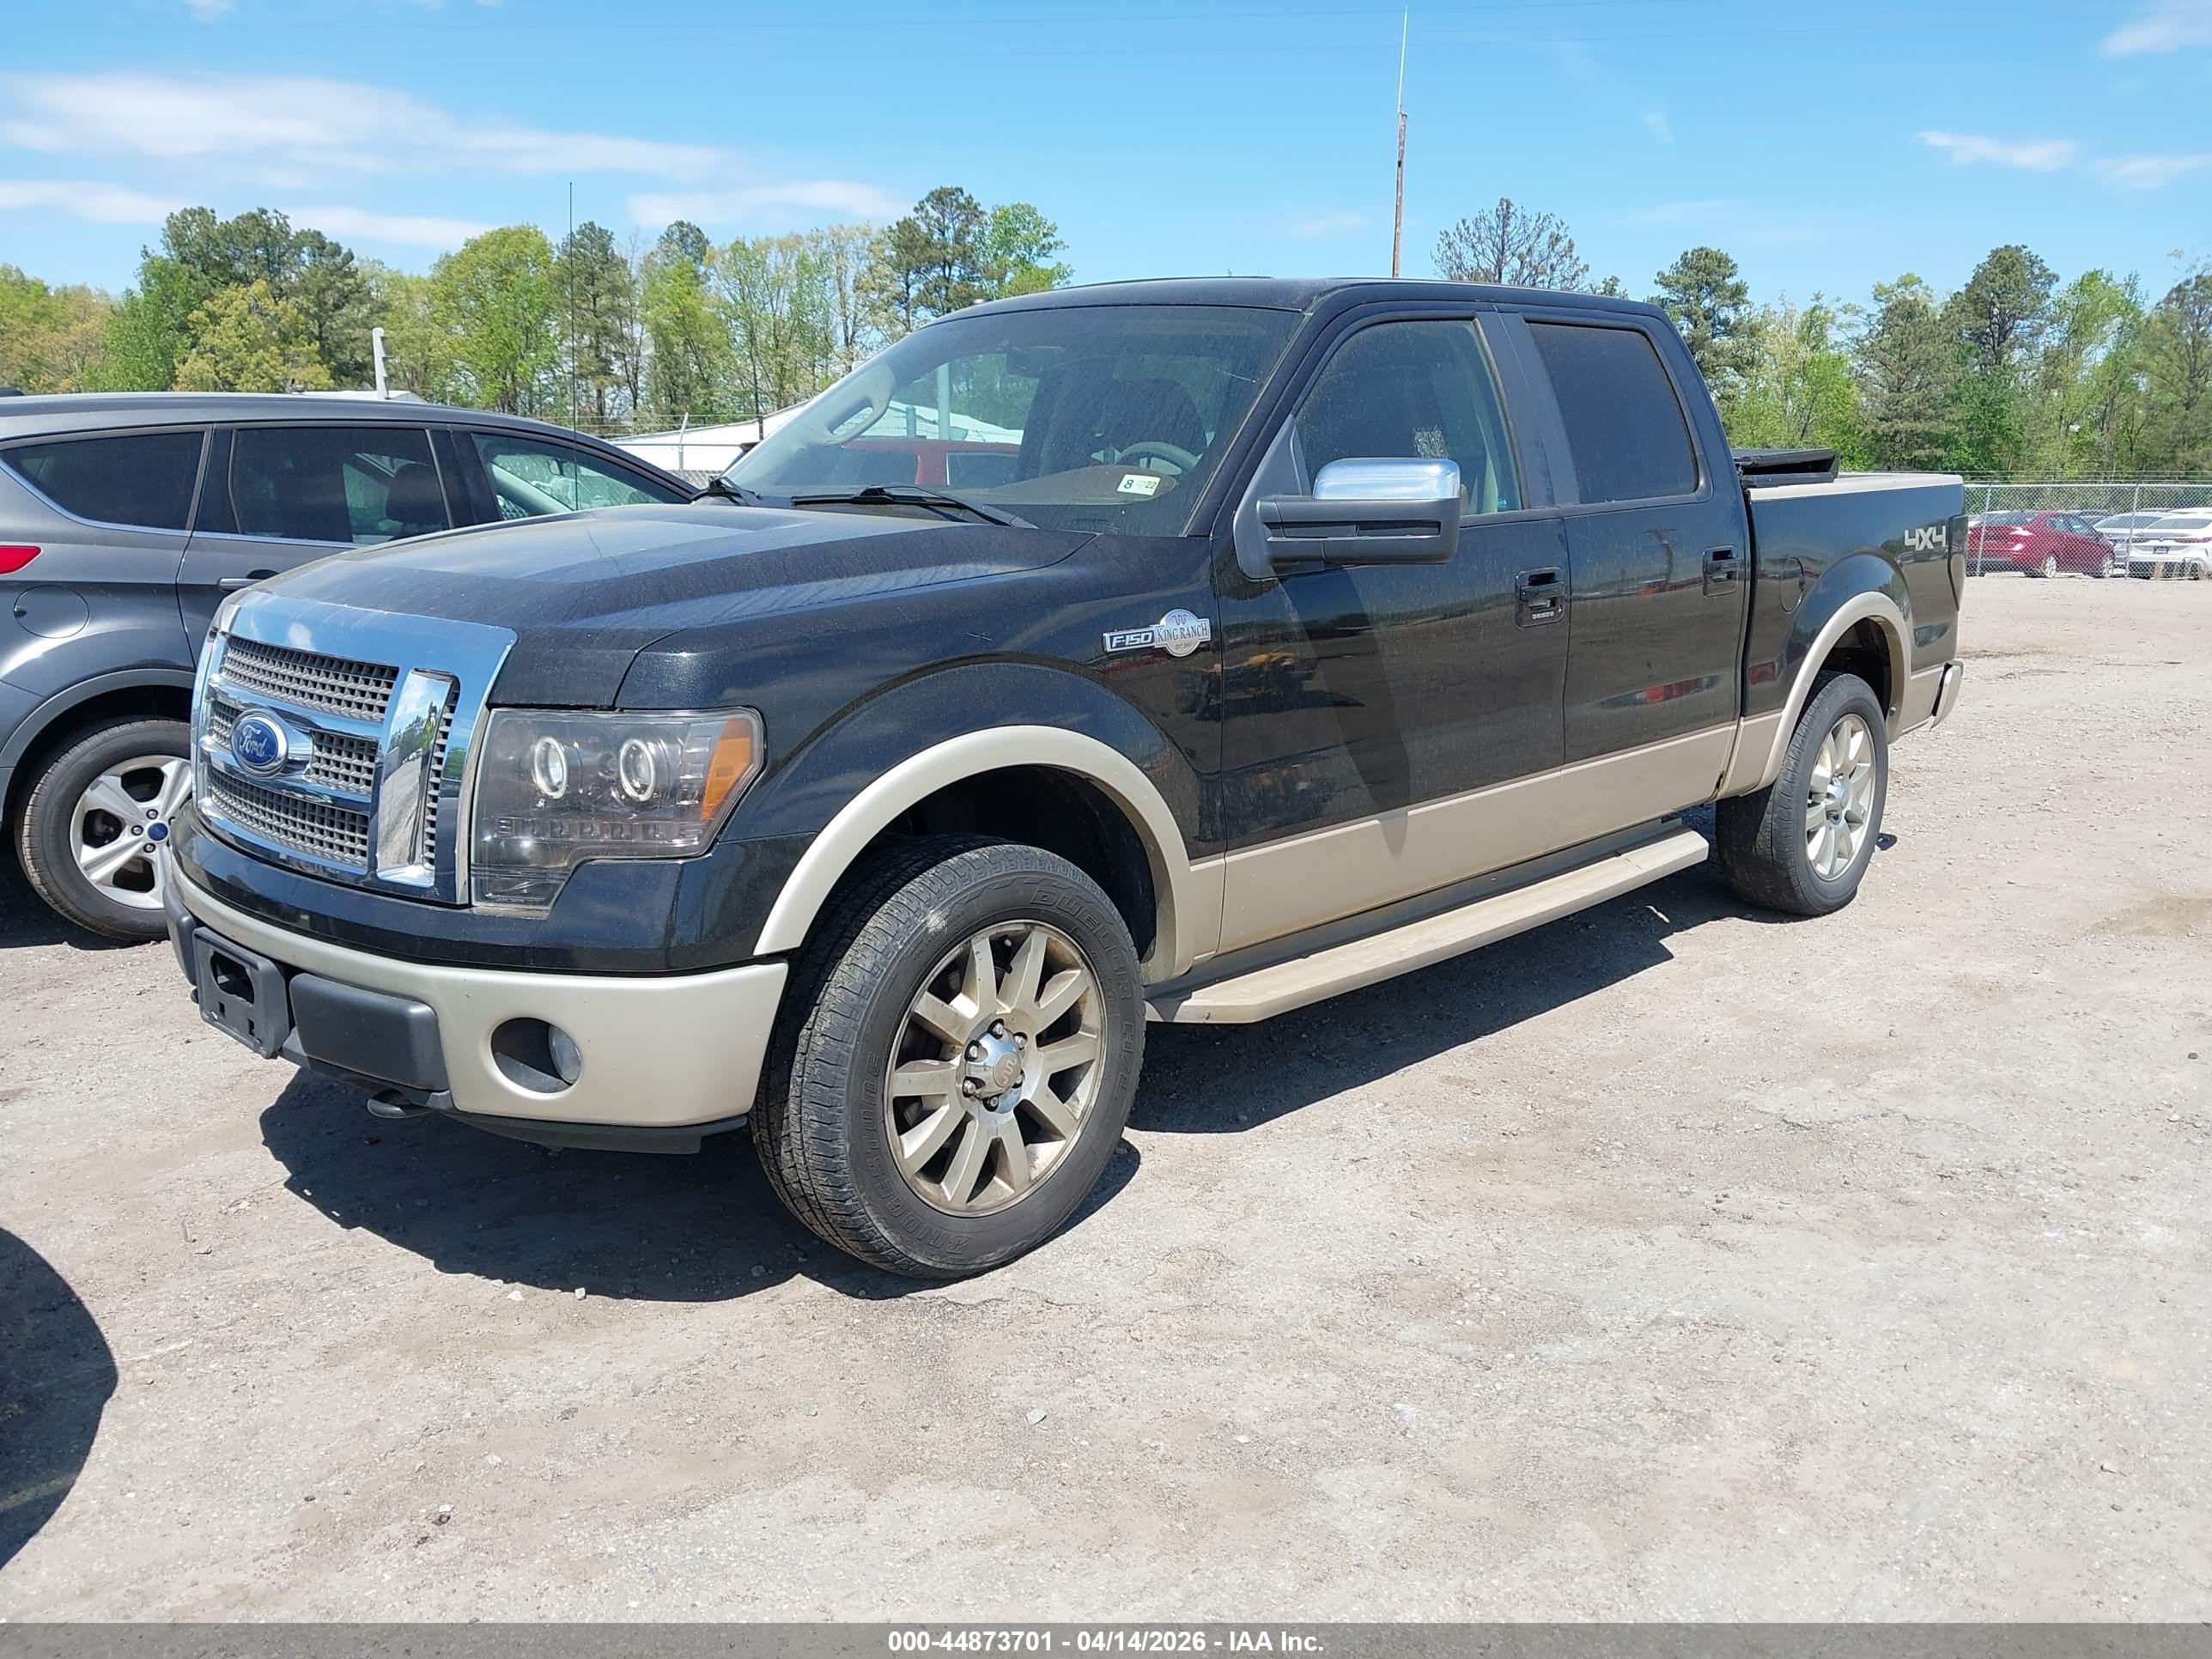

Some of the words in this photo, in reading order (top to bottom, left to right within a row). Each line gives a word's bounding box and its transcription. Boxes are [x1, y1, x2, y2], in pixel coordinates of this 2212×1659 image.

[1124, 479, 1134, 489] 8
[1904, 525, 1947, 551] 4X4
[1156, 627, 1178, 643] KING
[1180, 622, 1208, 640] RANCH
[240, 724, 268, 757] Ford
[861, 1051, 974, 1255] BRIDGESTONE
